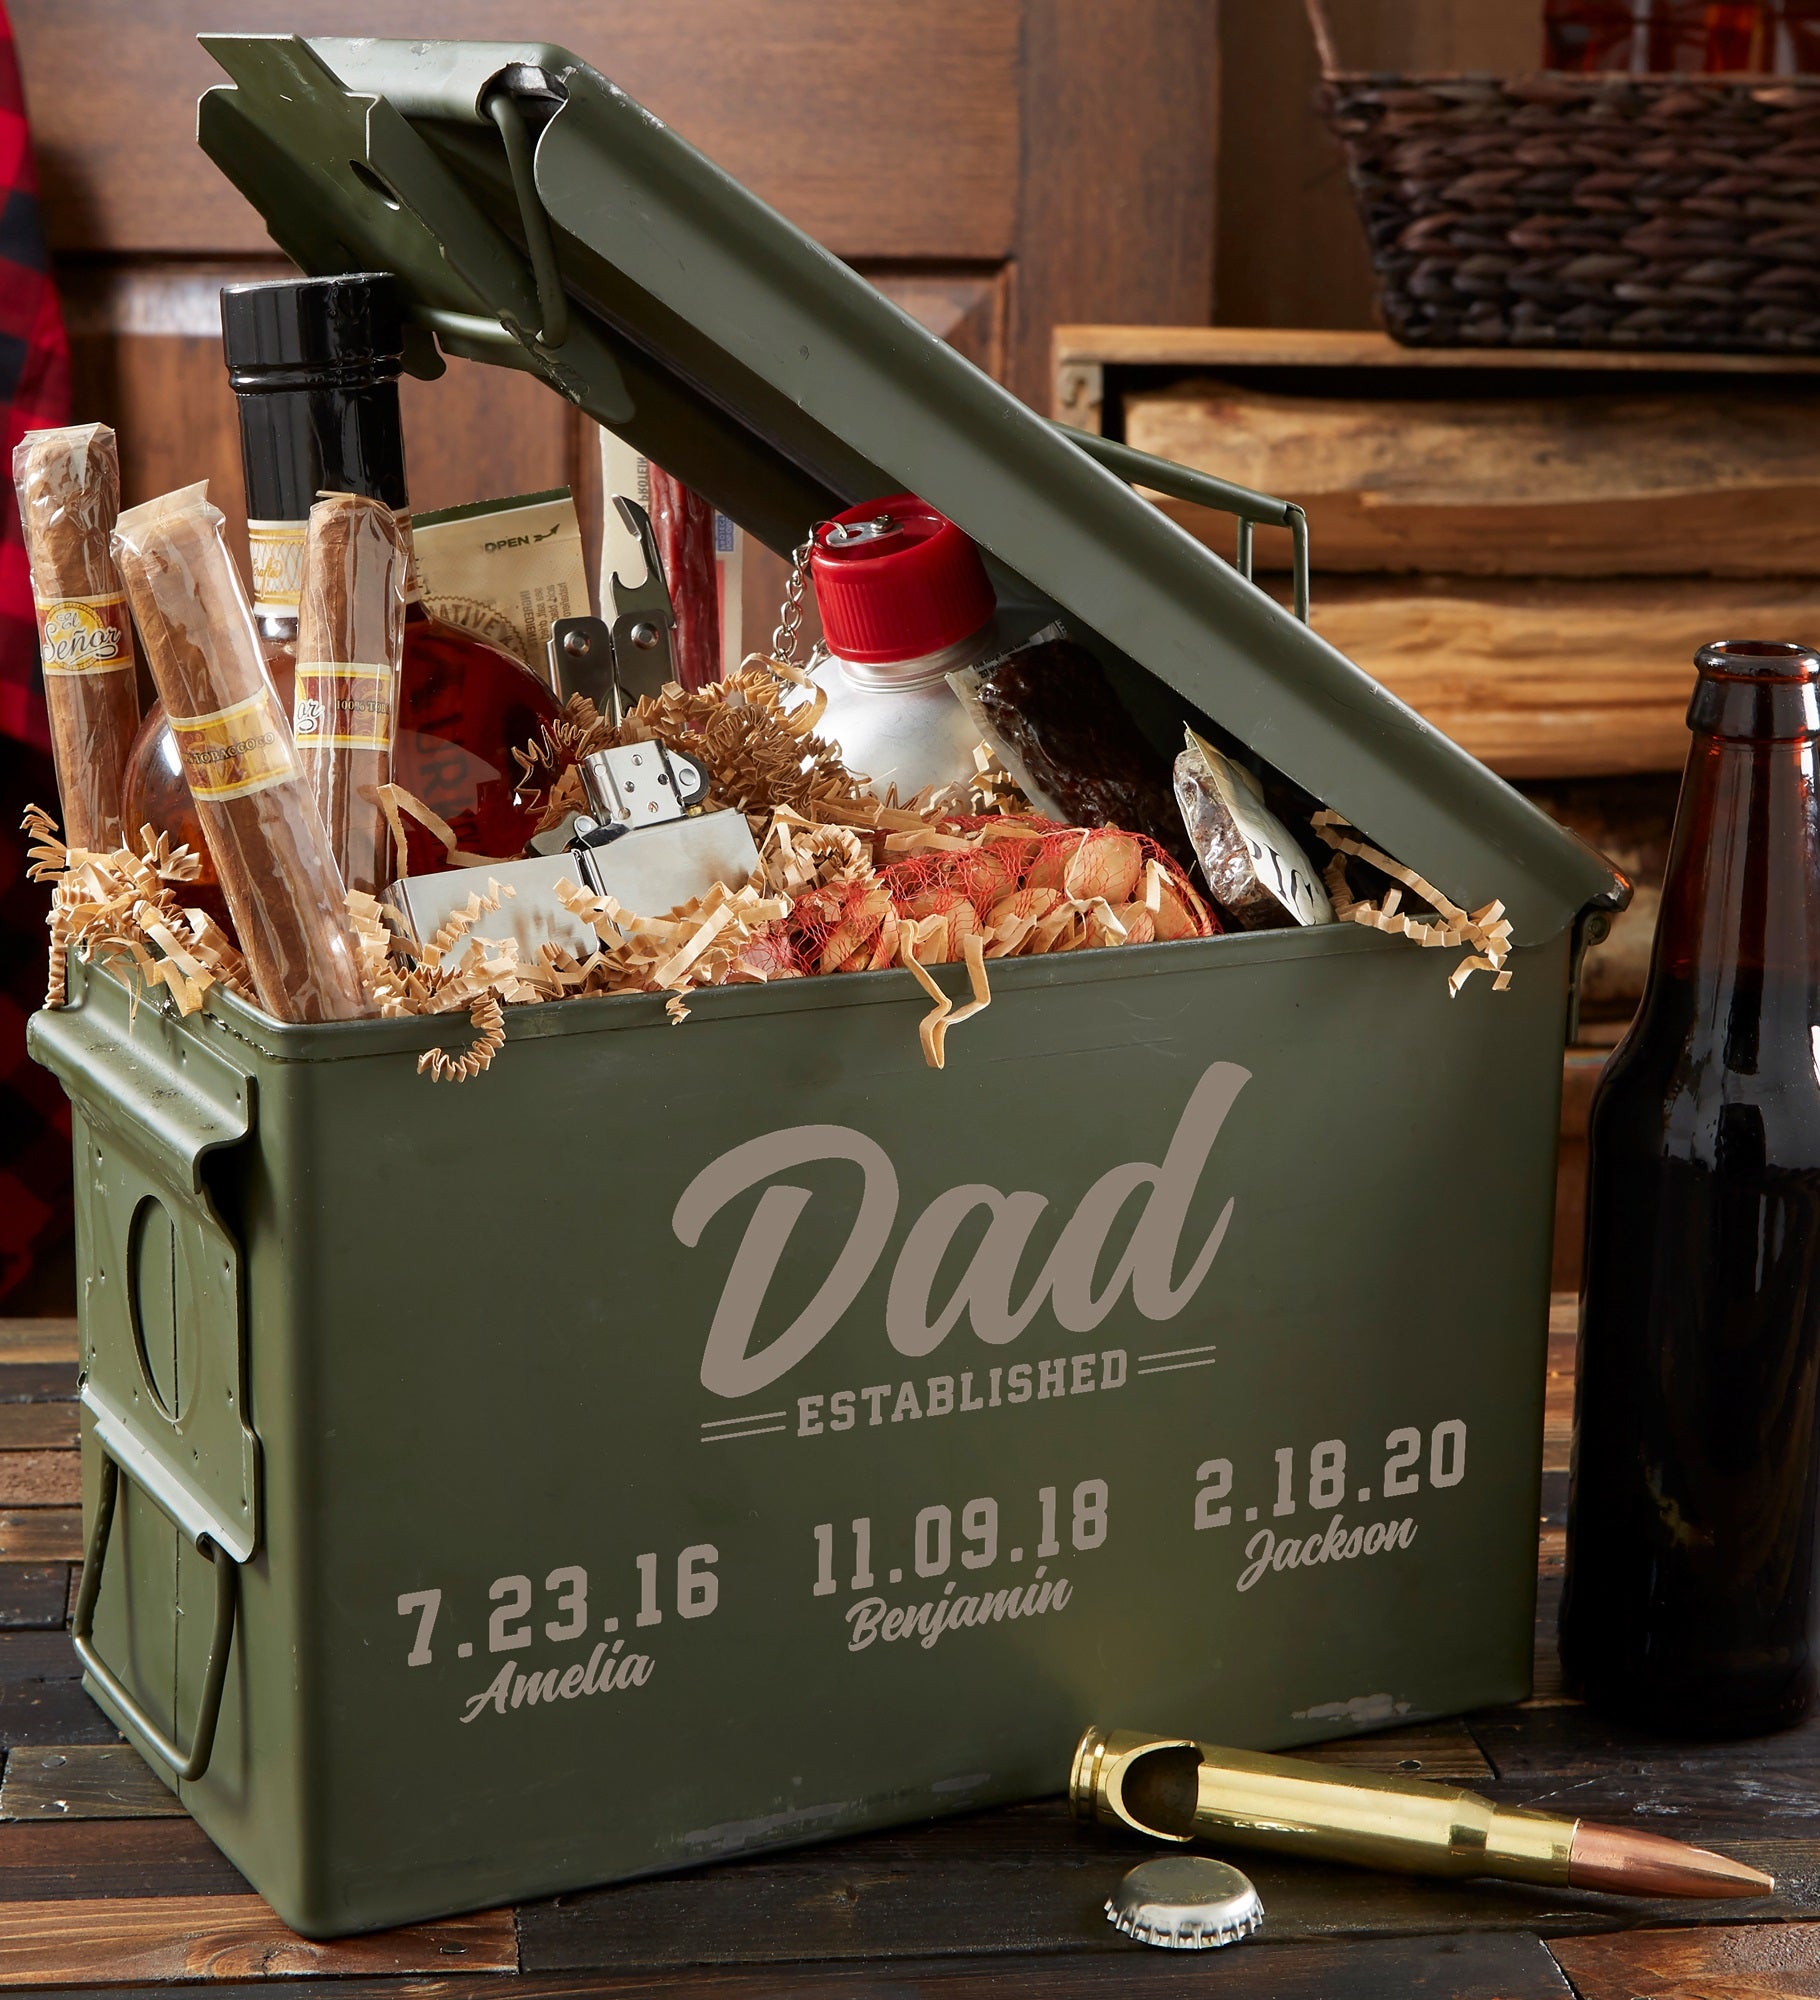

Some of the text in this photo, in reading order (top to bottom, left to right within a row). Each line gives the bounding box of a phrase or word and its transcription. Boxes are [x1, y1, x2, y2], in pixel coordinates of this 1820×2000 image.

[484, 535, 530, 553] OPEN
[43, 622, 122, 664] Señor
[56, 611, 80, 630] El
[335, 699, 366, 713] 100%
[193, 738, 257, 765] TOBACCO
[671, 1060, 1253, 1399] Dad
[797, 1349, 1128, 1437] ESTABLISHED
[1194, 1418, 1467, 1531] 2.18.20
[813, 1478, 1109, 1597] 11.09.18
[1236, 1514, 1418, 1592] Jackson
[397, 1543, 719, 1667] 7.23.16
[845, 1565, 1074, 1652] Benjamin
[459, 1639, 656, 1724] Amelia
